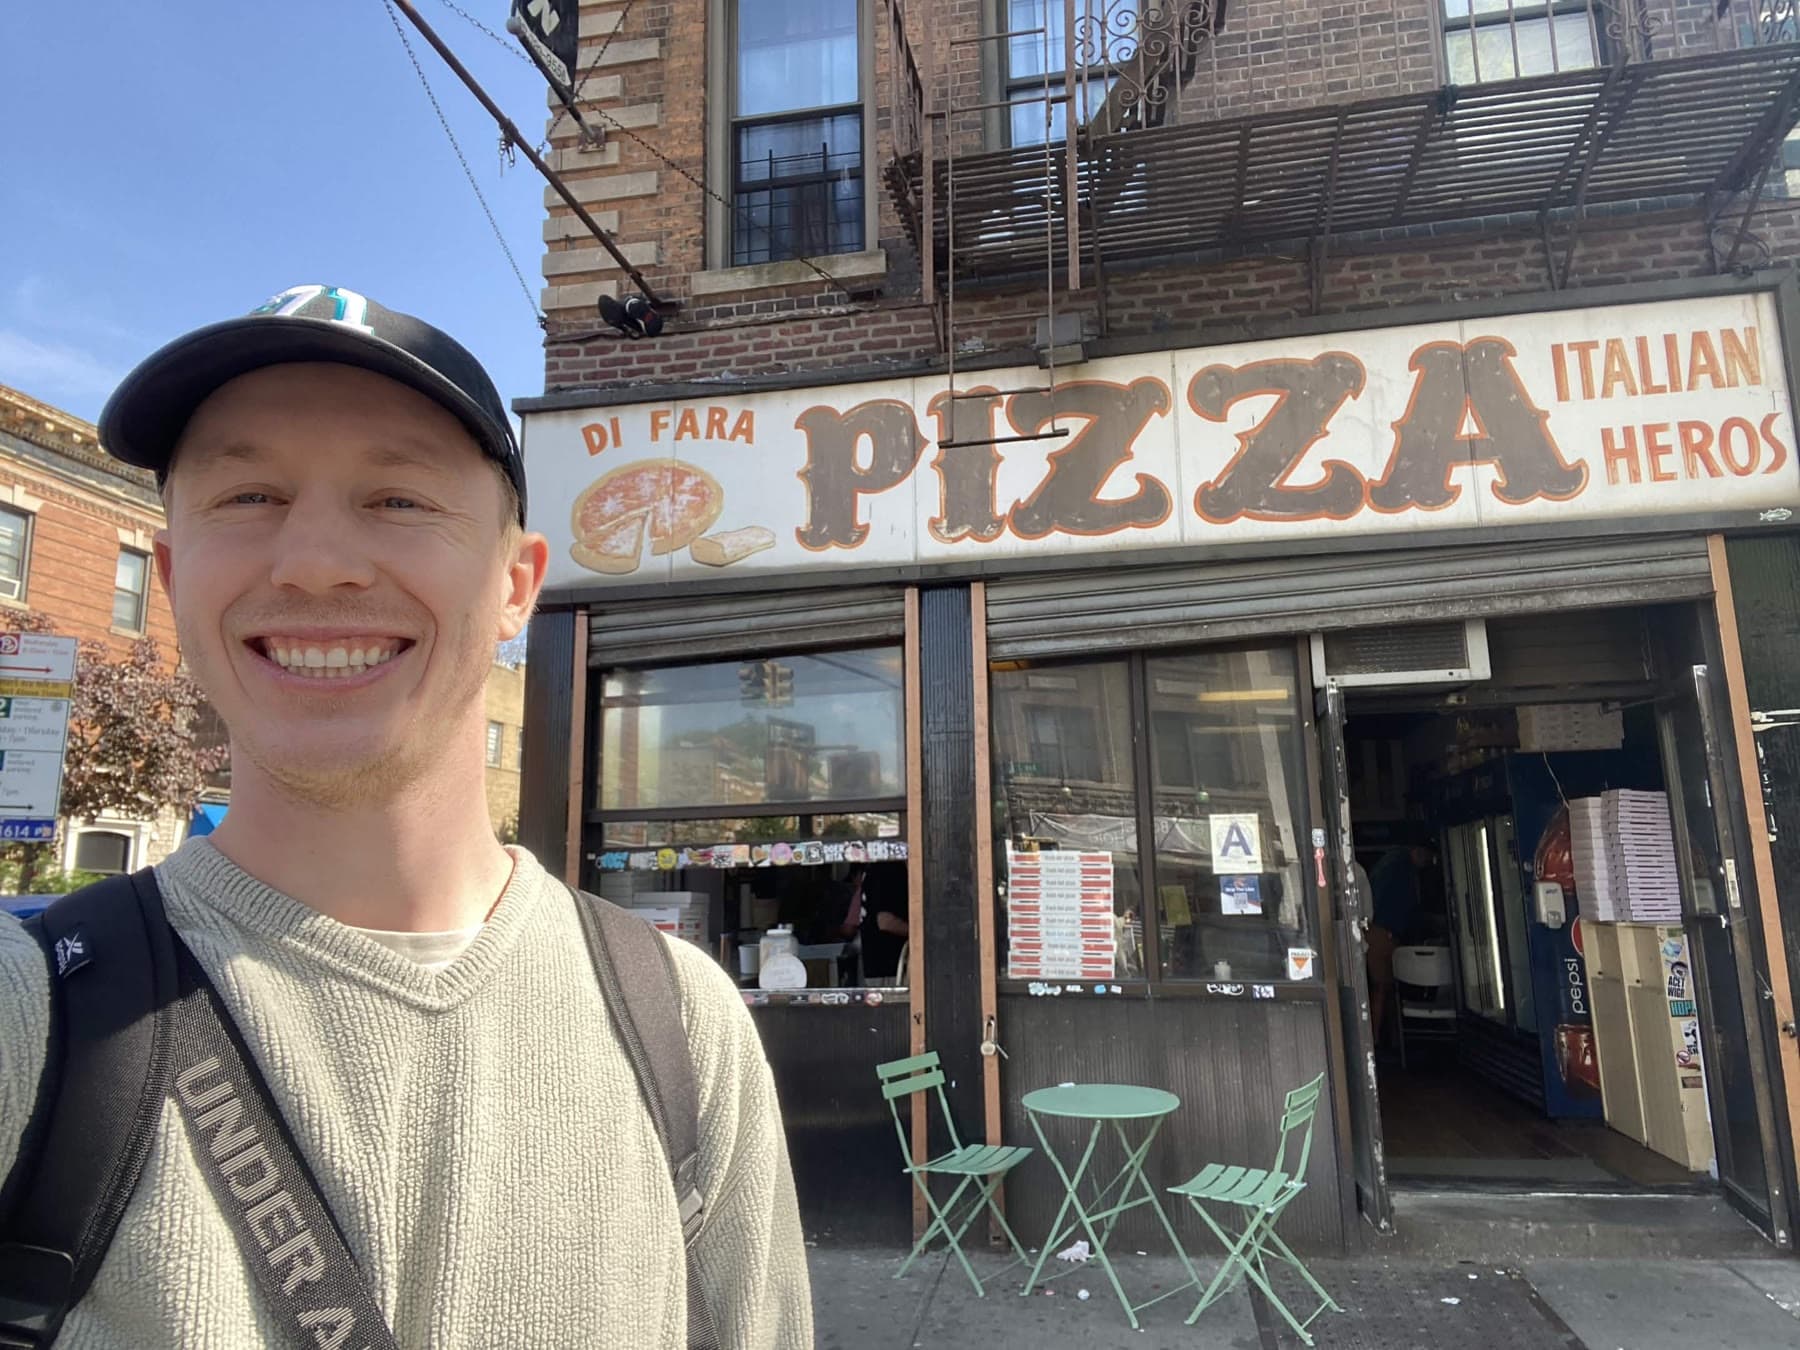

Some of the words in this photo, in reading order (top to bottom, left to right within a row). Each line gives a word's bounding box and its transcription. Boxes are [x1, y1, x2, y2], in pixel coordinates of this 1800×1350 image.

[1551, 326, 1762, 402] ITALIAN
[581, 417, 623, 457] DI
[650, 406, 756, 445] FARA
[794, 335, 1589, 551] PIZZA
[1601, 412, 1788, 486] HEROS
[1220, 820, 1253, 857] A
[1564, 958, 1588, 1014] pepsi
[175, 1056, 328, 1296] UNDER
